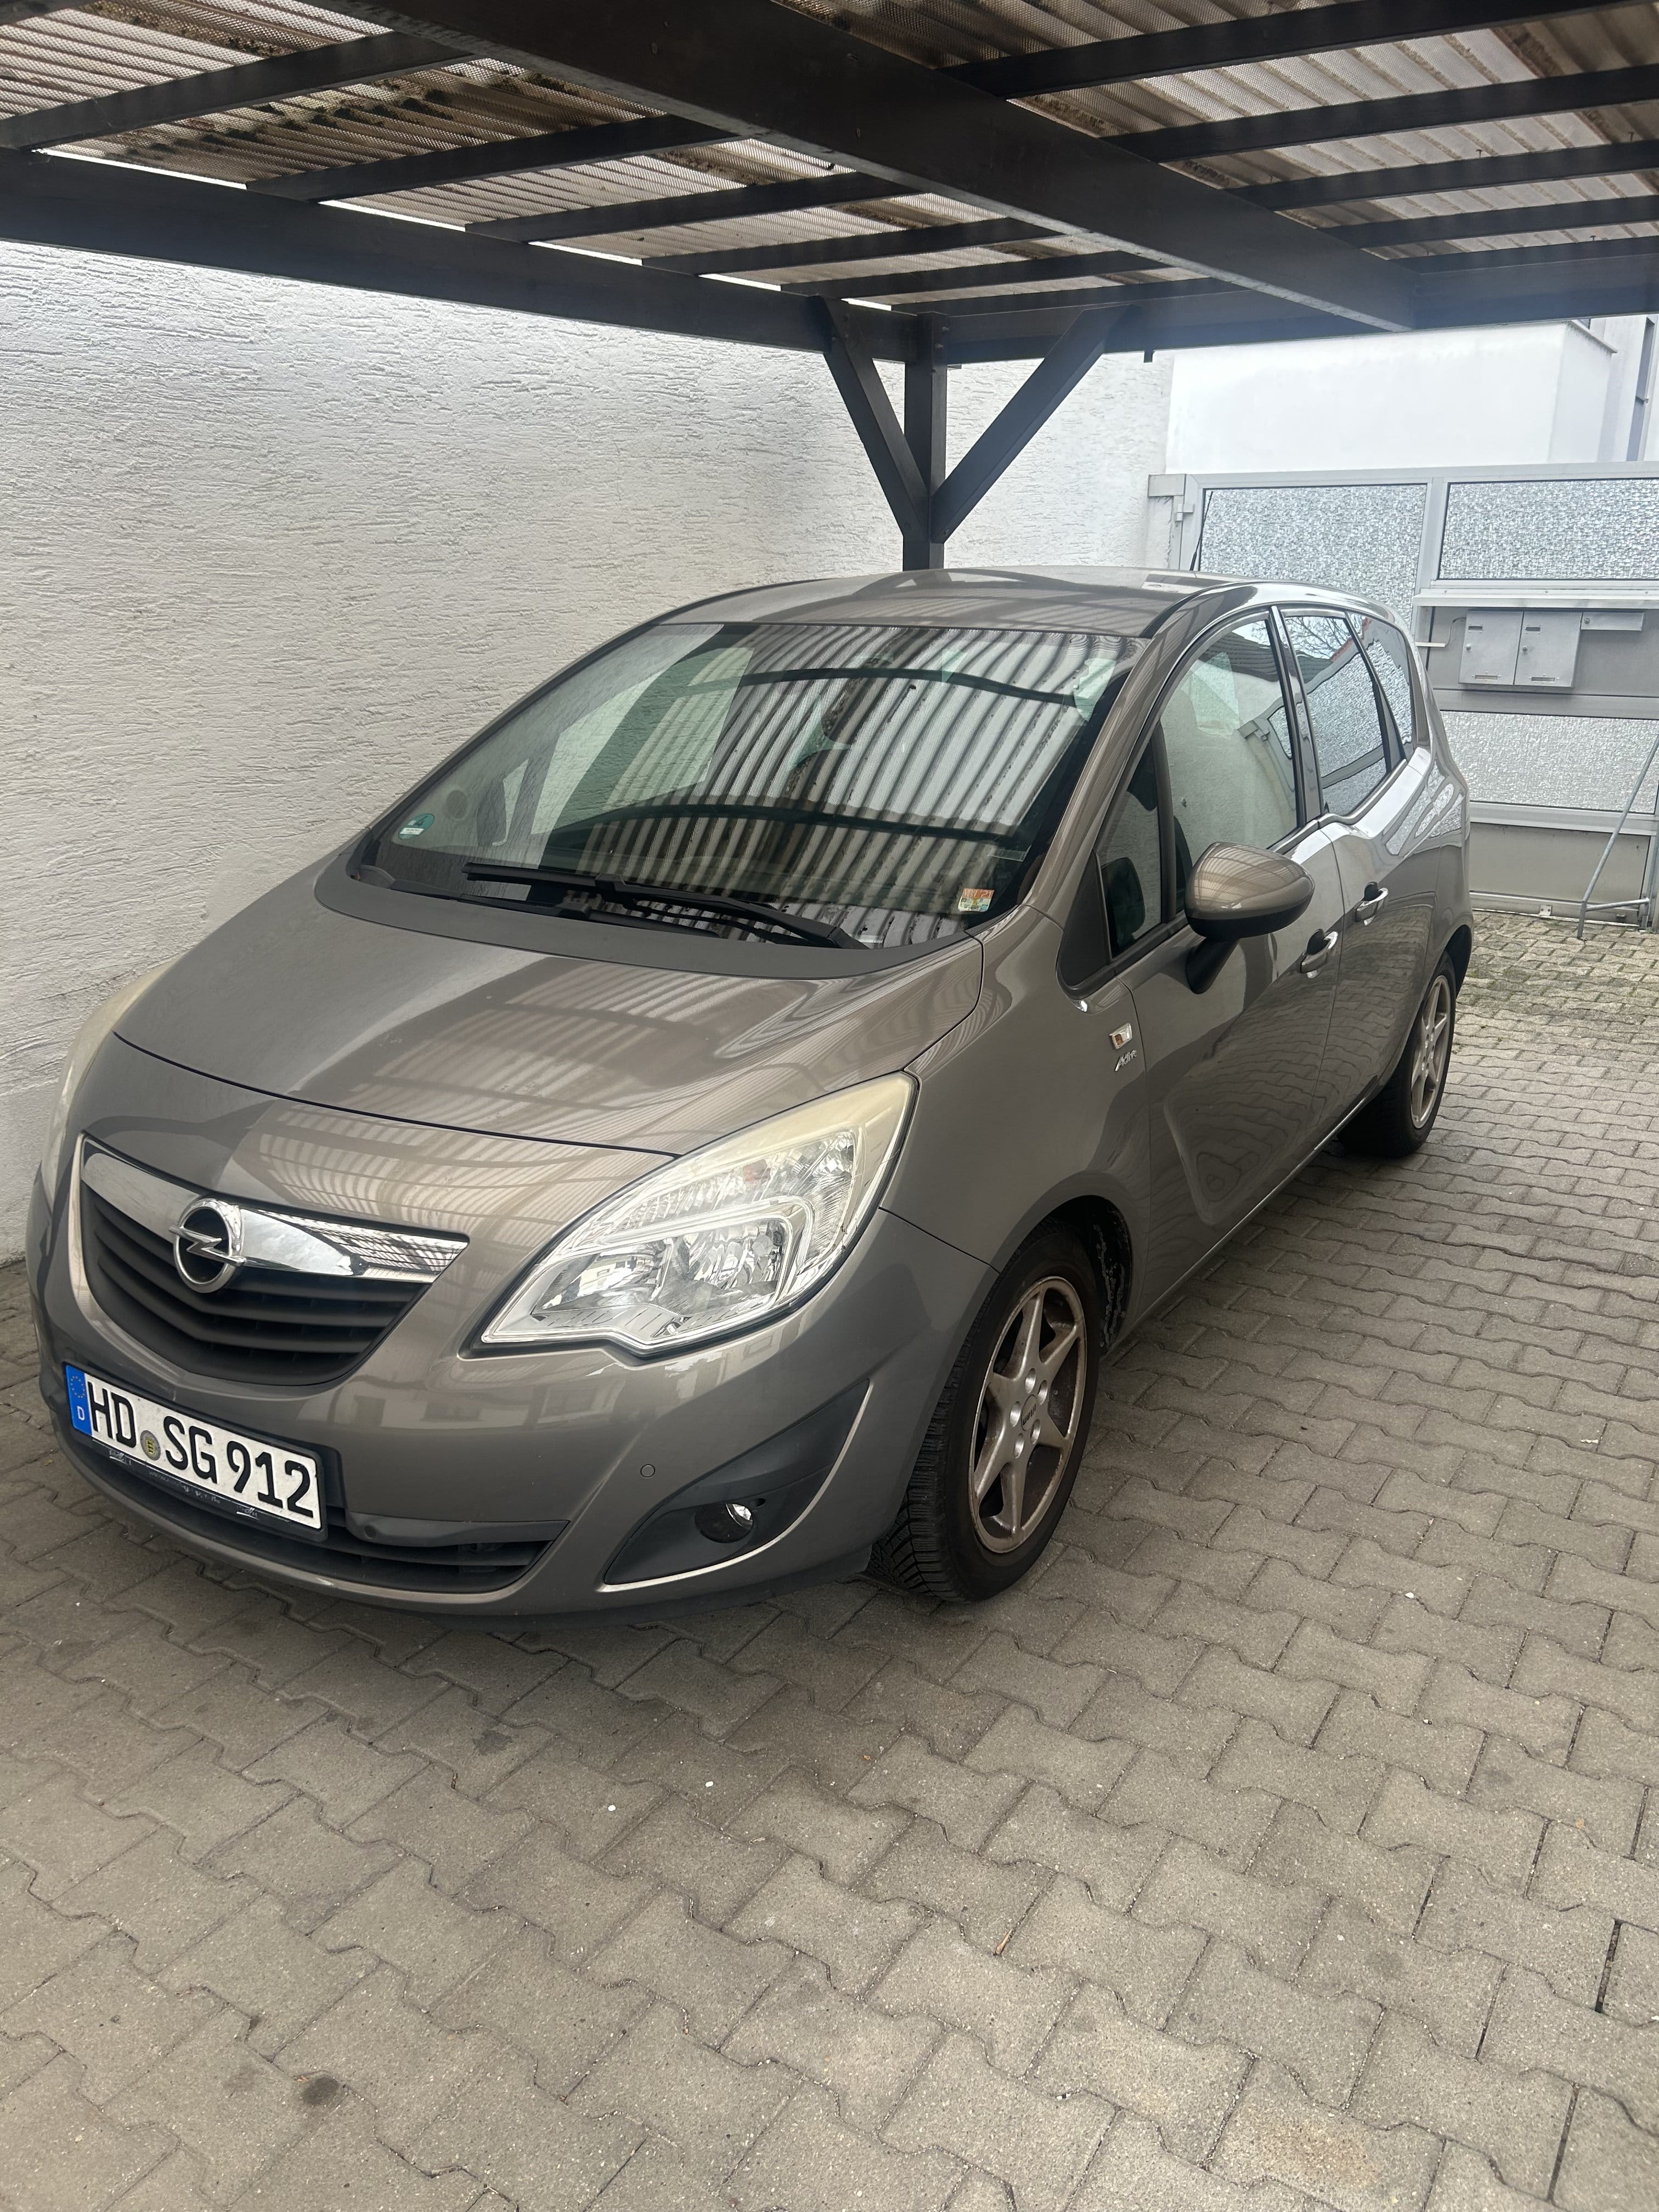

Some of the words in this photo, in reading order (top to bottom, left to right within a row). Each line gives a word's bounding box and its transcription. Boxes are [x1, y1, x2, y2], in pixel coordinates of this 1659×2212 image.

[77, 1406, 85, 1421] D
[87, 1381, 137, 1448] HD
[163, 1415, 218, 1484] SG
[226, 1440, 314, 1519] 912
